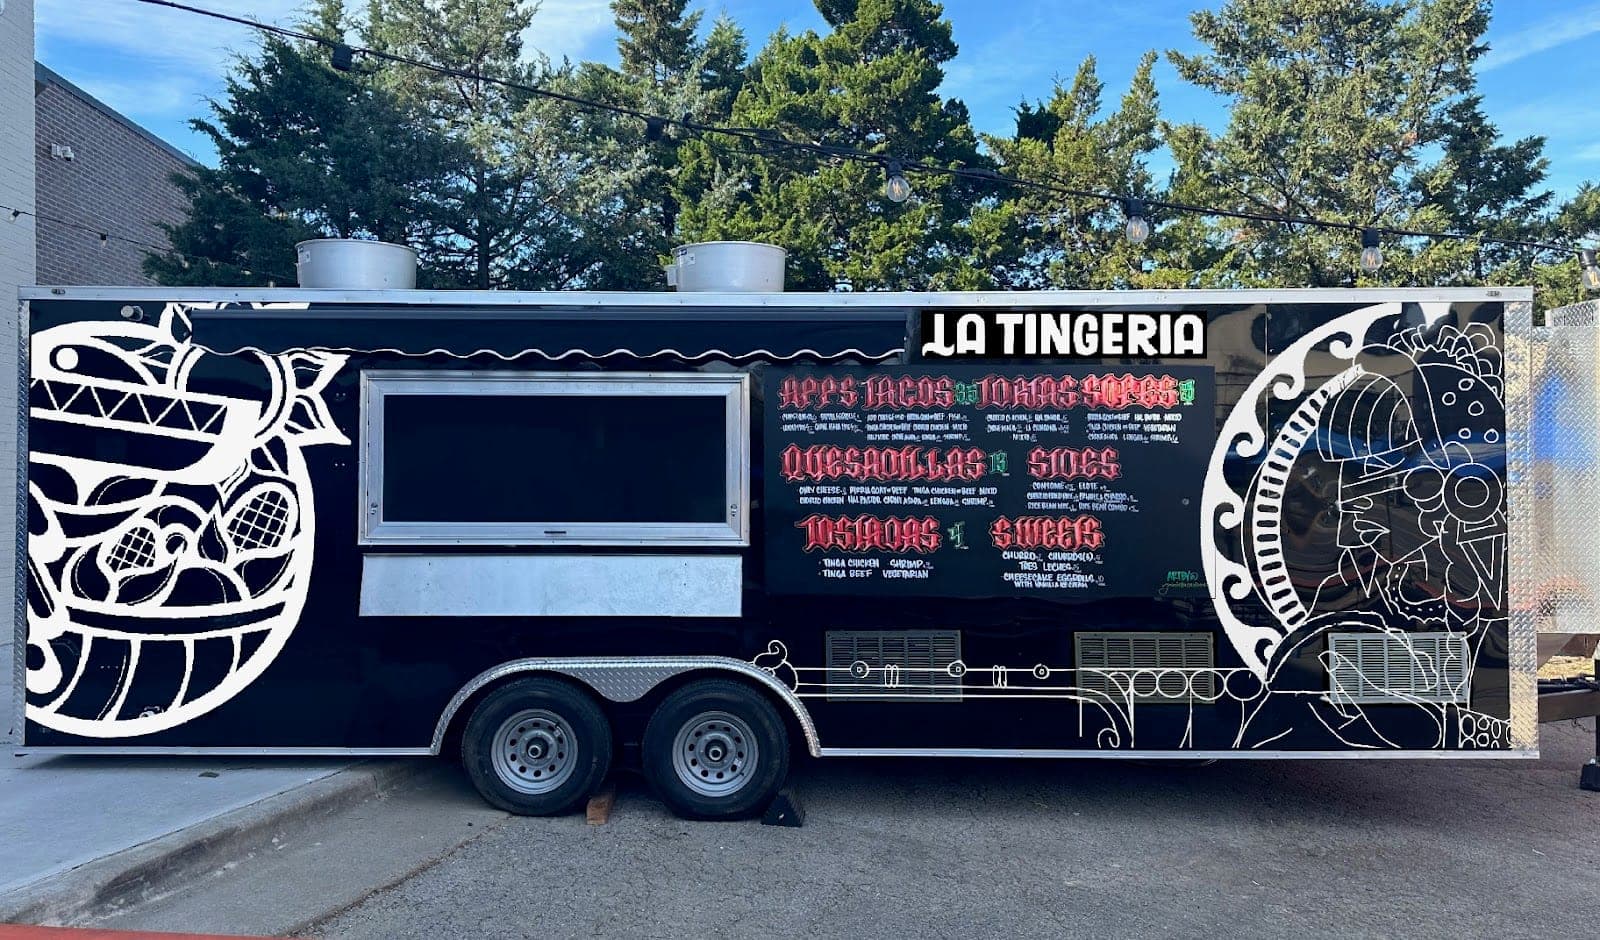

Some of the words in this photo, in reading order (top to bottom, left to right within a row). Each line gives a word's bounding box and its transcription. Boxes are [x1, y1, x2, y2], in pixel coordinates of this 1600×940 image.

[922, 313, 986, 357] LA
[995, 313, 1204, 356] TINGERIA
[778, 374, 859, 410] APPS
[861, 373, 955, 410] TACOS
[1080, 373, 1179, 410] SOPES
[780, 442, 988, 483] QUESADILLAS
[1026, 445, 1122, 480] SIDES
[794, 512, 943, 554] TOSTADAS
[989, 514, 1105, 551] SWEETS
[822, 558, 846, 567] TINGA
[847, 558, 879, 568] CHICKEN
[822, 569, 846, 578] TINGA
[849, 569, 872, 578] BEEF
[889, 558, 923, 569] SHRIMP
[1002, 551, 1036, 561] CHURRO
[1018, 561, 1038, 571] TRES
[882, 569, 929, 579] VEGETARIAN
[1003, 572, 1053, 582] CHEESECAKE
